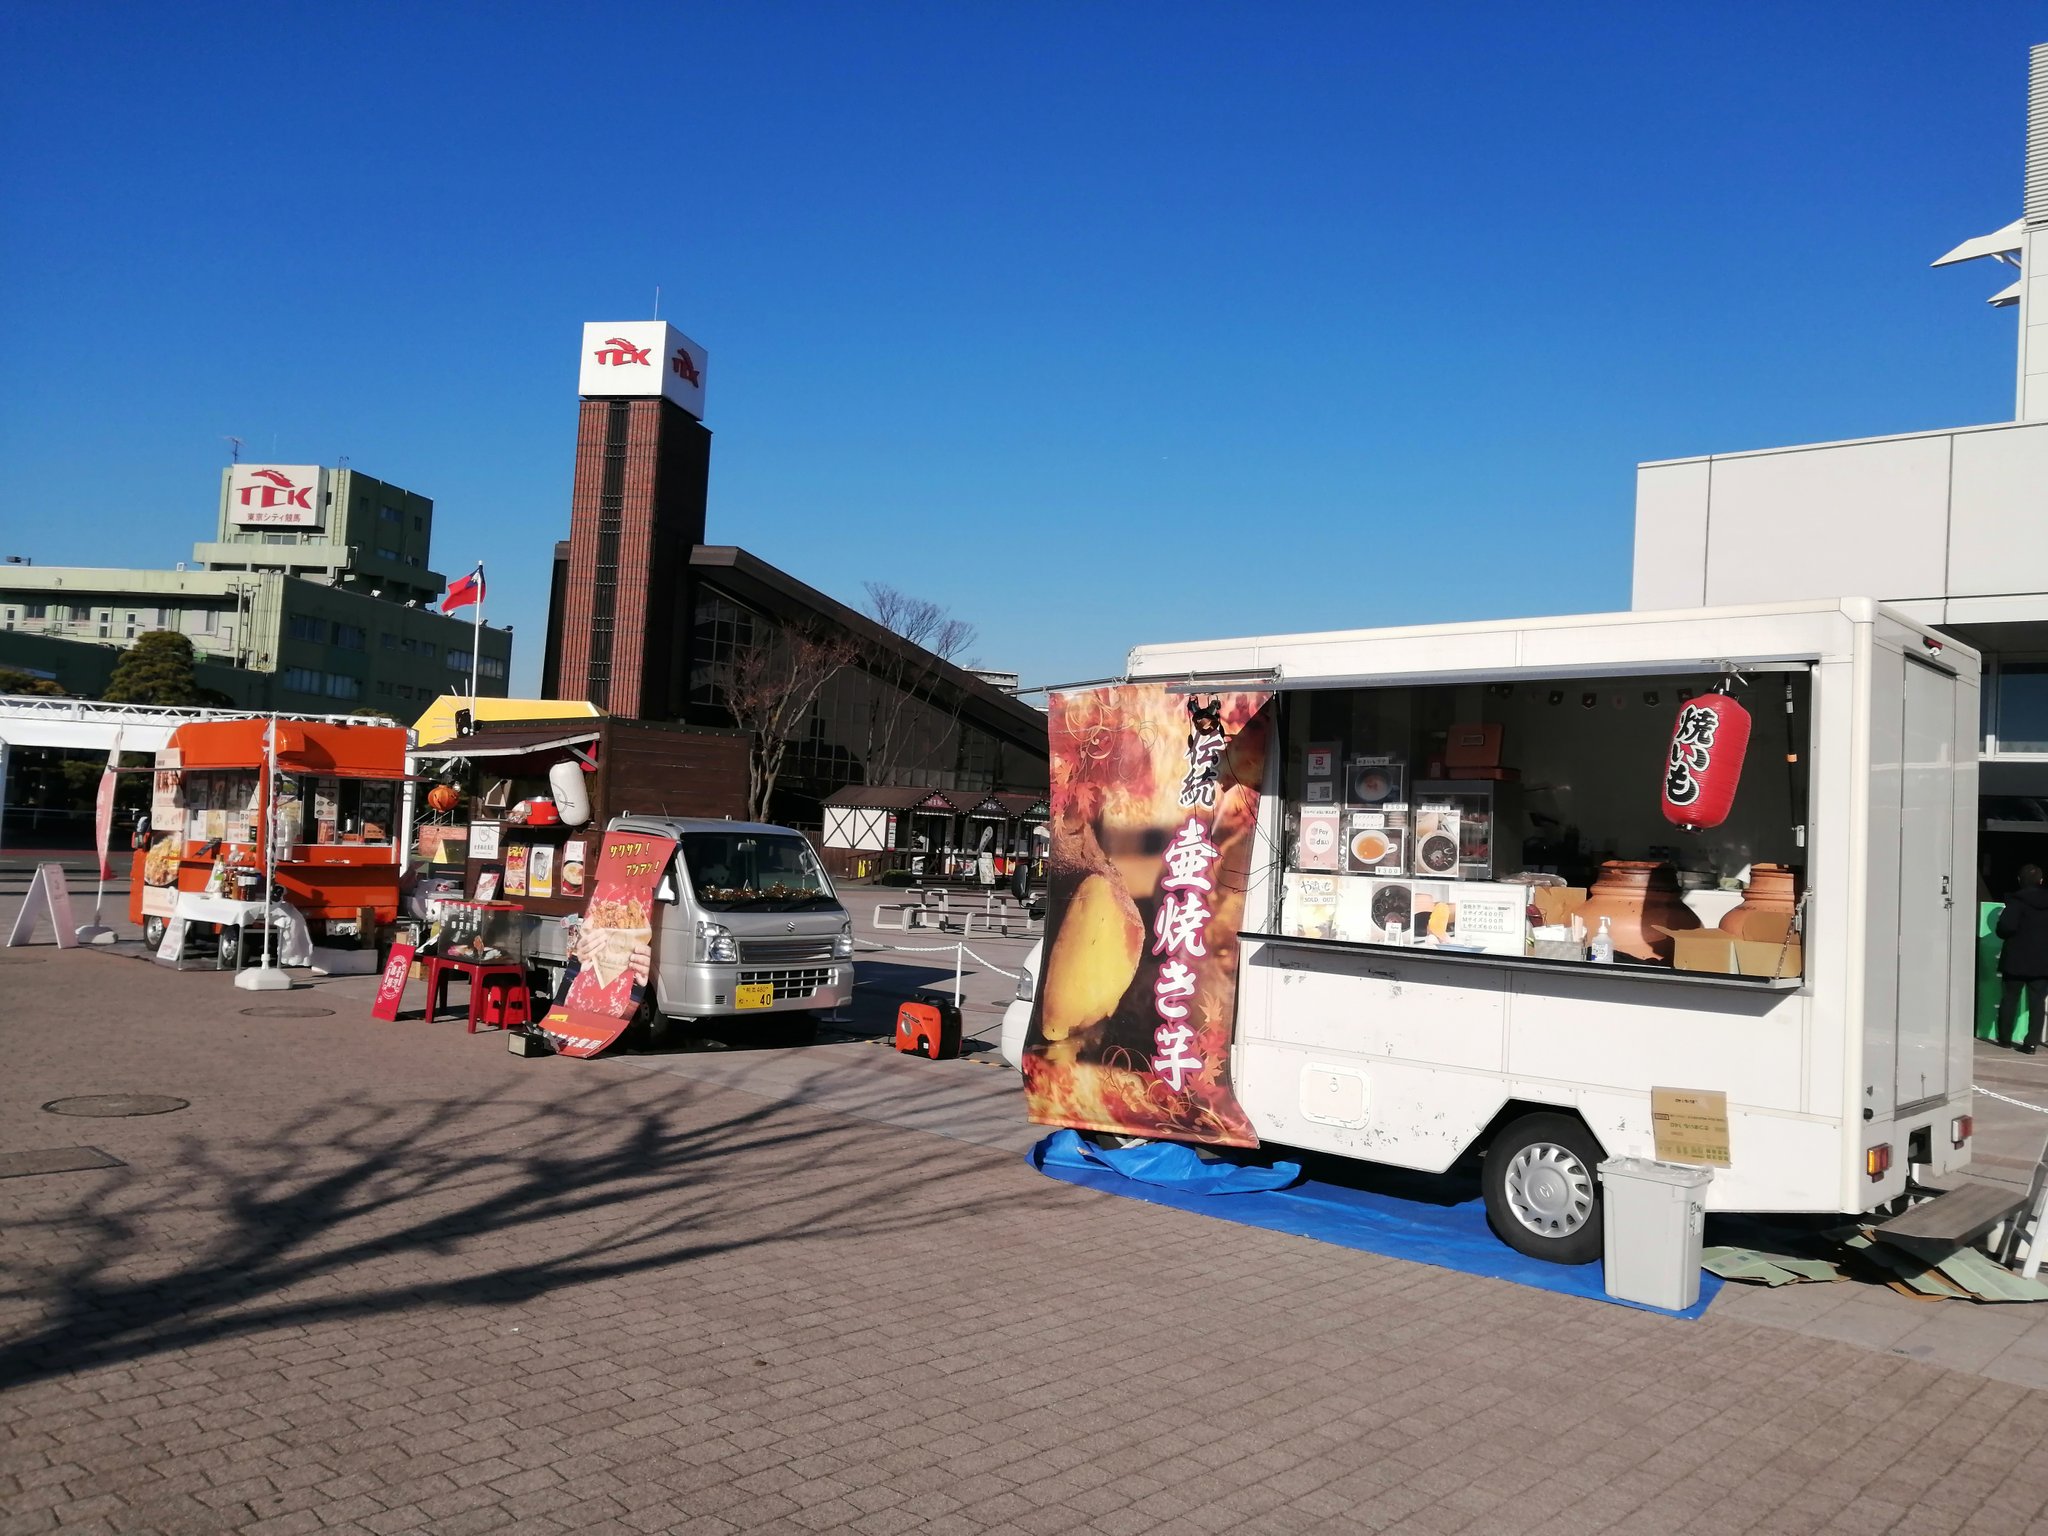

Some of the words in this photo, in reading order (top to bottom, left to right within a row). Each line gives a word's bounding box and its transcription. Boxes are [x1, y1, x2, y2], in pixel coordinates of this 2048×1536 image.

[236, 485, 314, 510] TCK
[247, 513, 301, 522] 東京シティ競馬
[1180, 725, 1225, 808] 伝統
[1666, 704, 1719, 806] 焼いも
[760, 993, 771, 1006] 40
